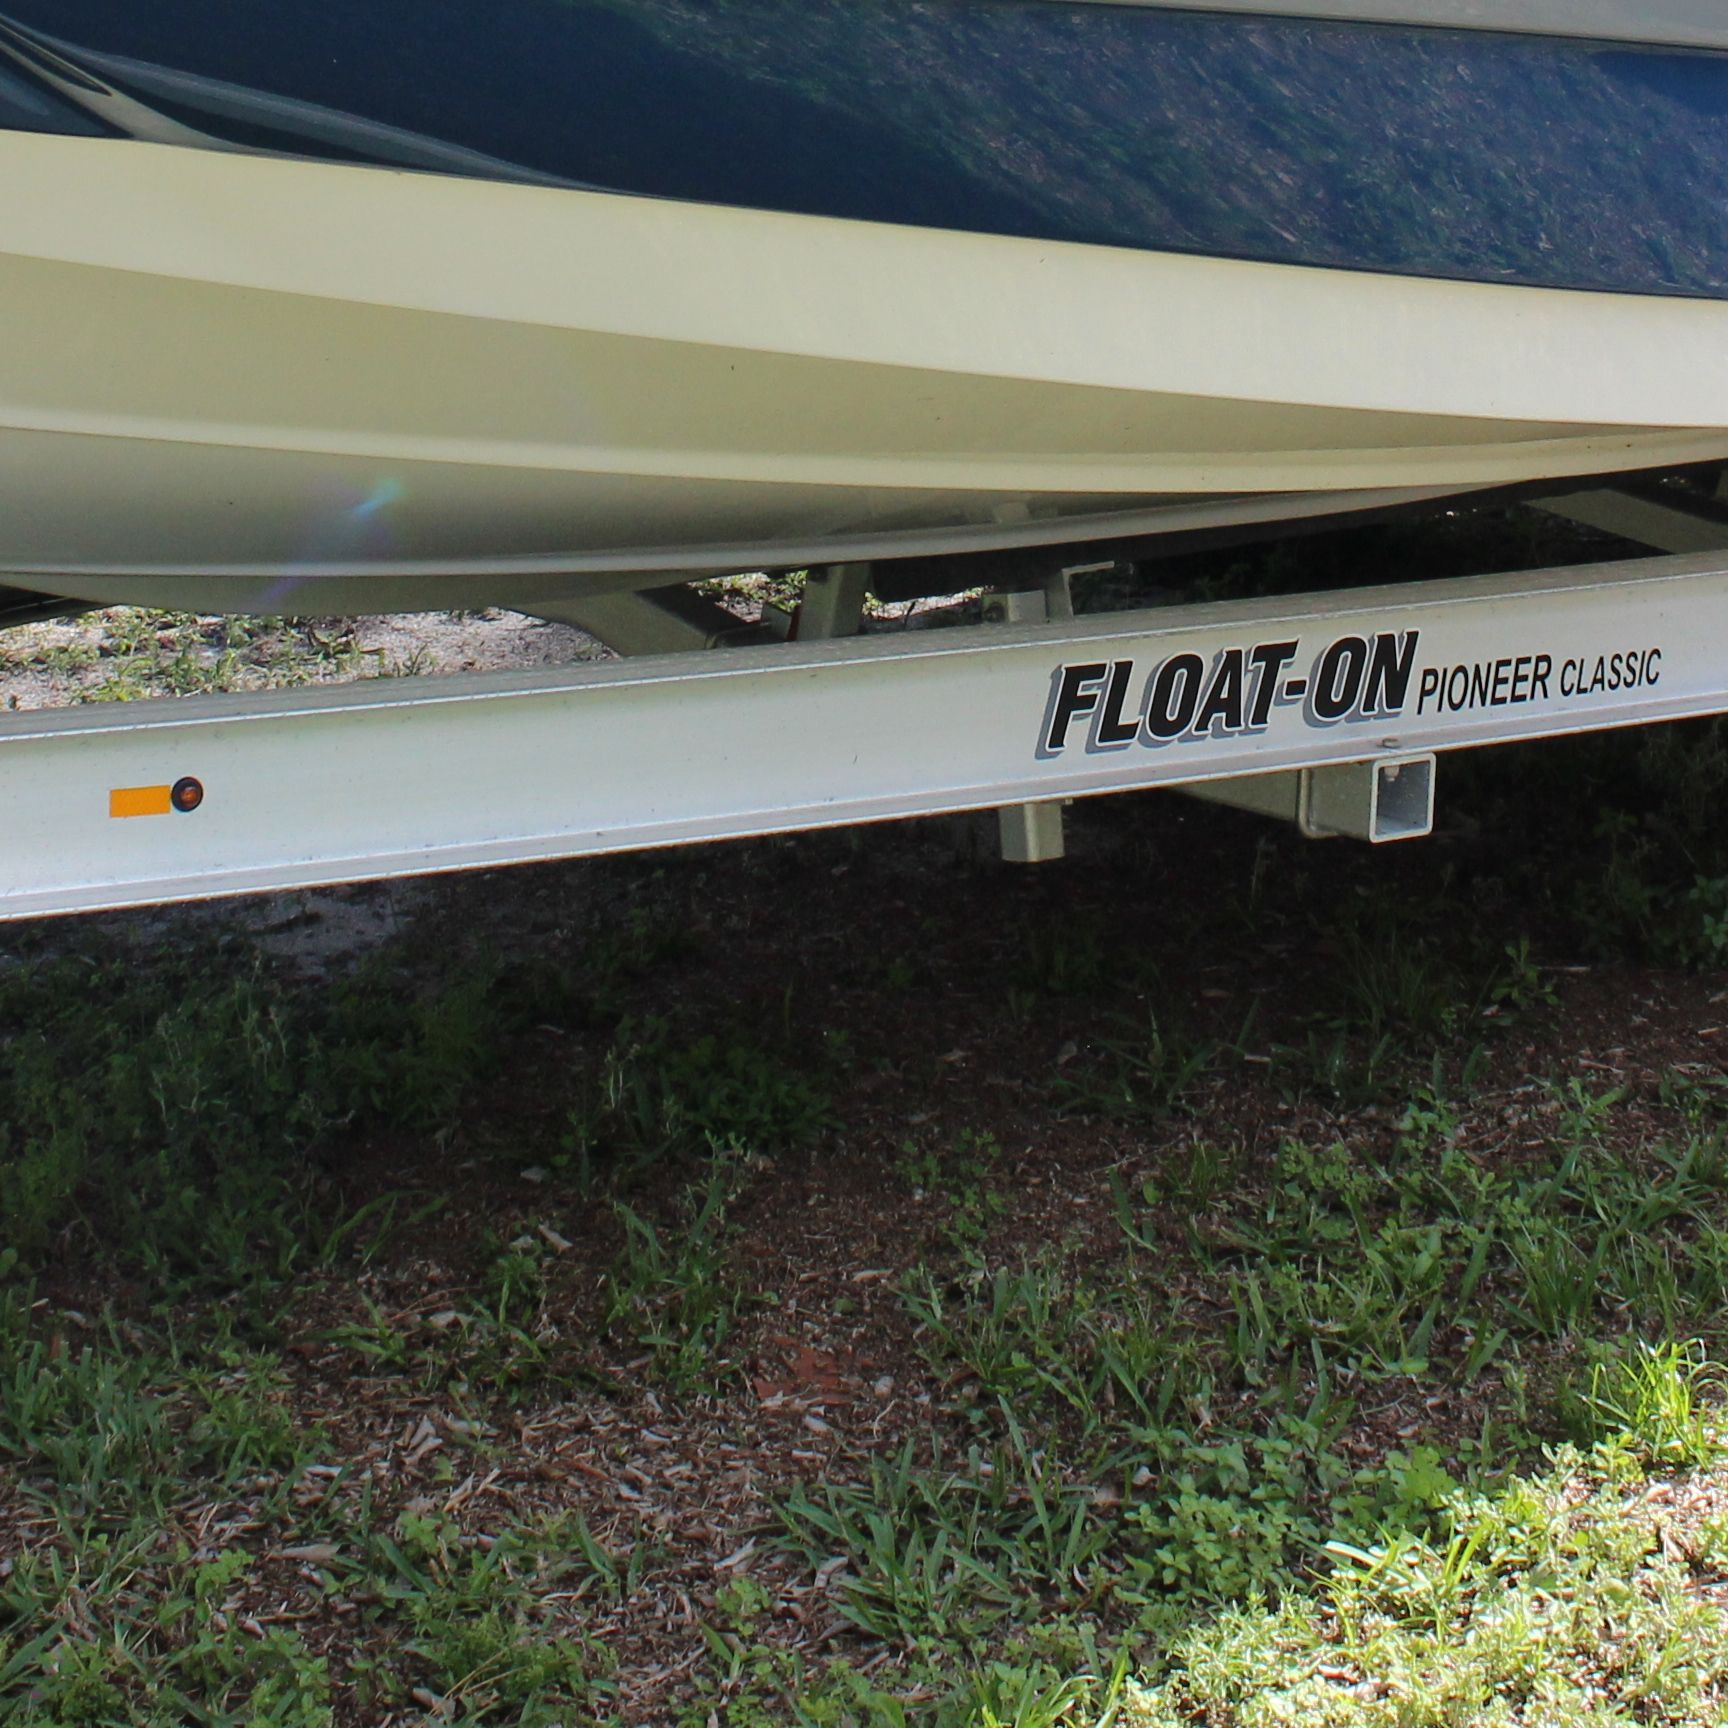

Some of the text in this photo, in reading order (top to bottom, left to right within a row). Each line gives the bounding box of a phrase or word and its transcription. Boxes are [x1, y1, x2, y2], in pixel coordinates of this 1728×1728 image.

[1036, 629, 1663, 759] FLOAT-ON PIONEER CLASSIC
